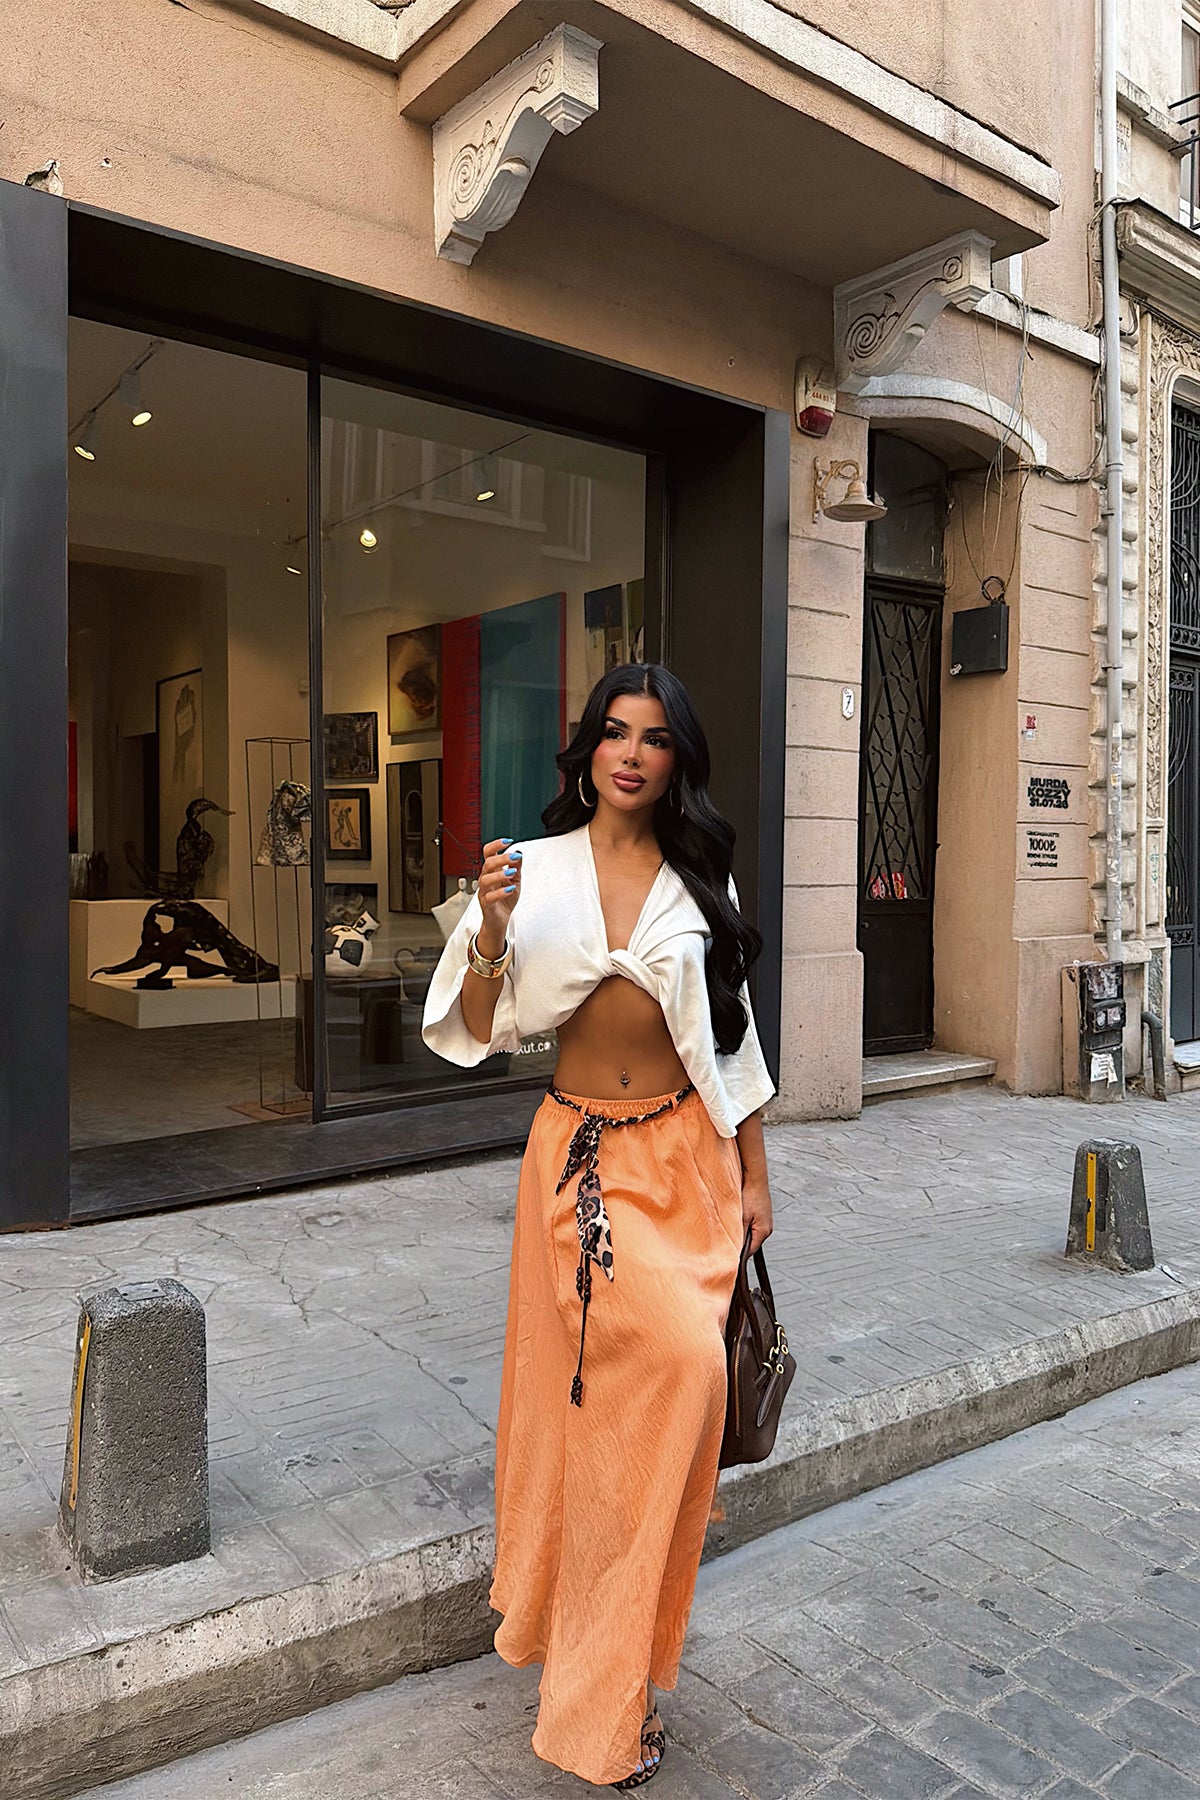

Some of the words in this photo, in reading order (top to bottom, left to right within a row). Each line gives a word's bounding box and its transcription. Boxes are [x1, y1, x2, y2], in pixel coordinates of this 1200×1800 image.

[846, 695, 852, 710] 7
[1030, 777, 1068, 789] MURDA
[1028, 787, 1071, 801] KOZZY
